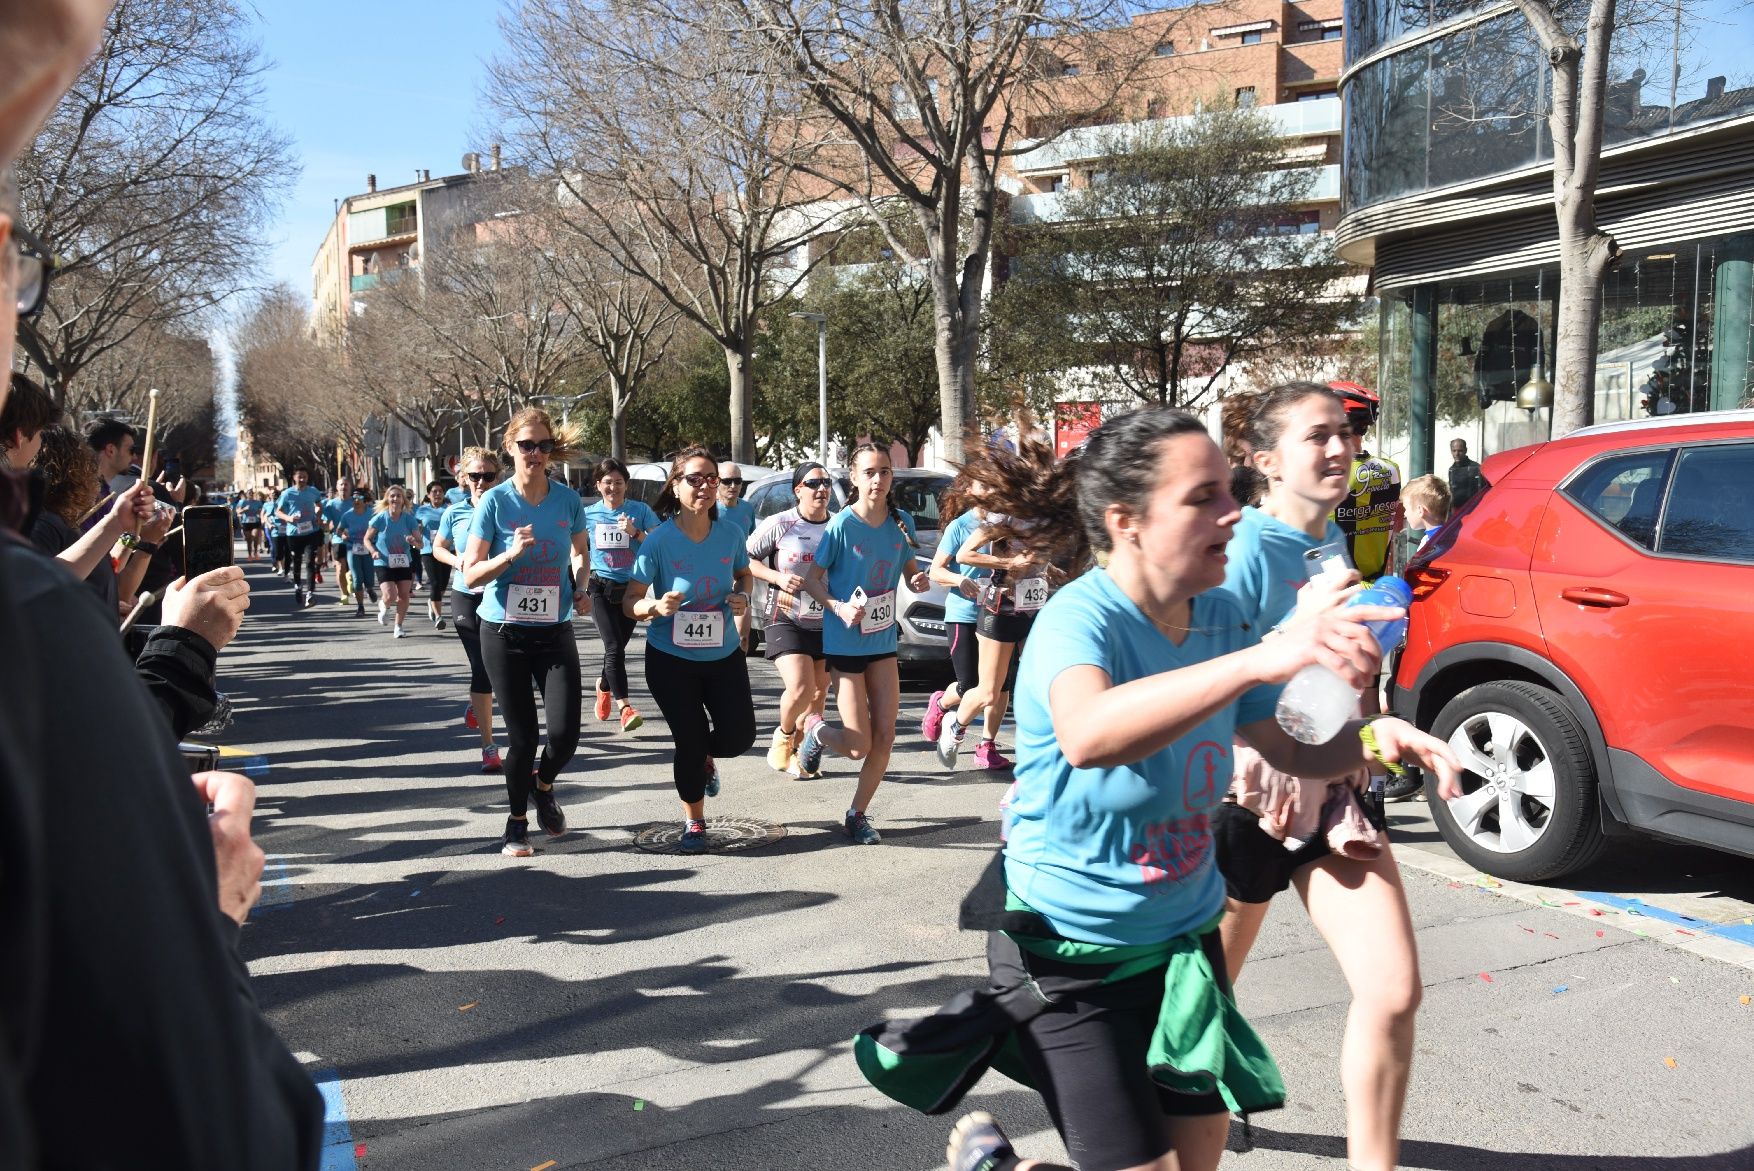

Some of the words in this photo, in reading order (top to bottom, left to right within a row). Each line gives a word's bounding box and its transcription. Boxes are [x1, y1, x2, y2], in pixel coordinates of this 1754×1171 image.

[1337, 505, 1371, 519] Berga
[602, 532, 622, 542] 110
[1024, 588, 1044, 601] 432
[518, 597, 547, 612] 431
[871, 605, 890, 621] 430
[684, 623, 712, 637] 441
